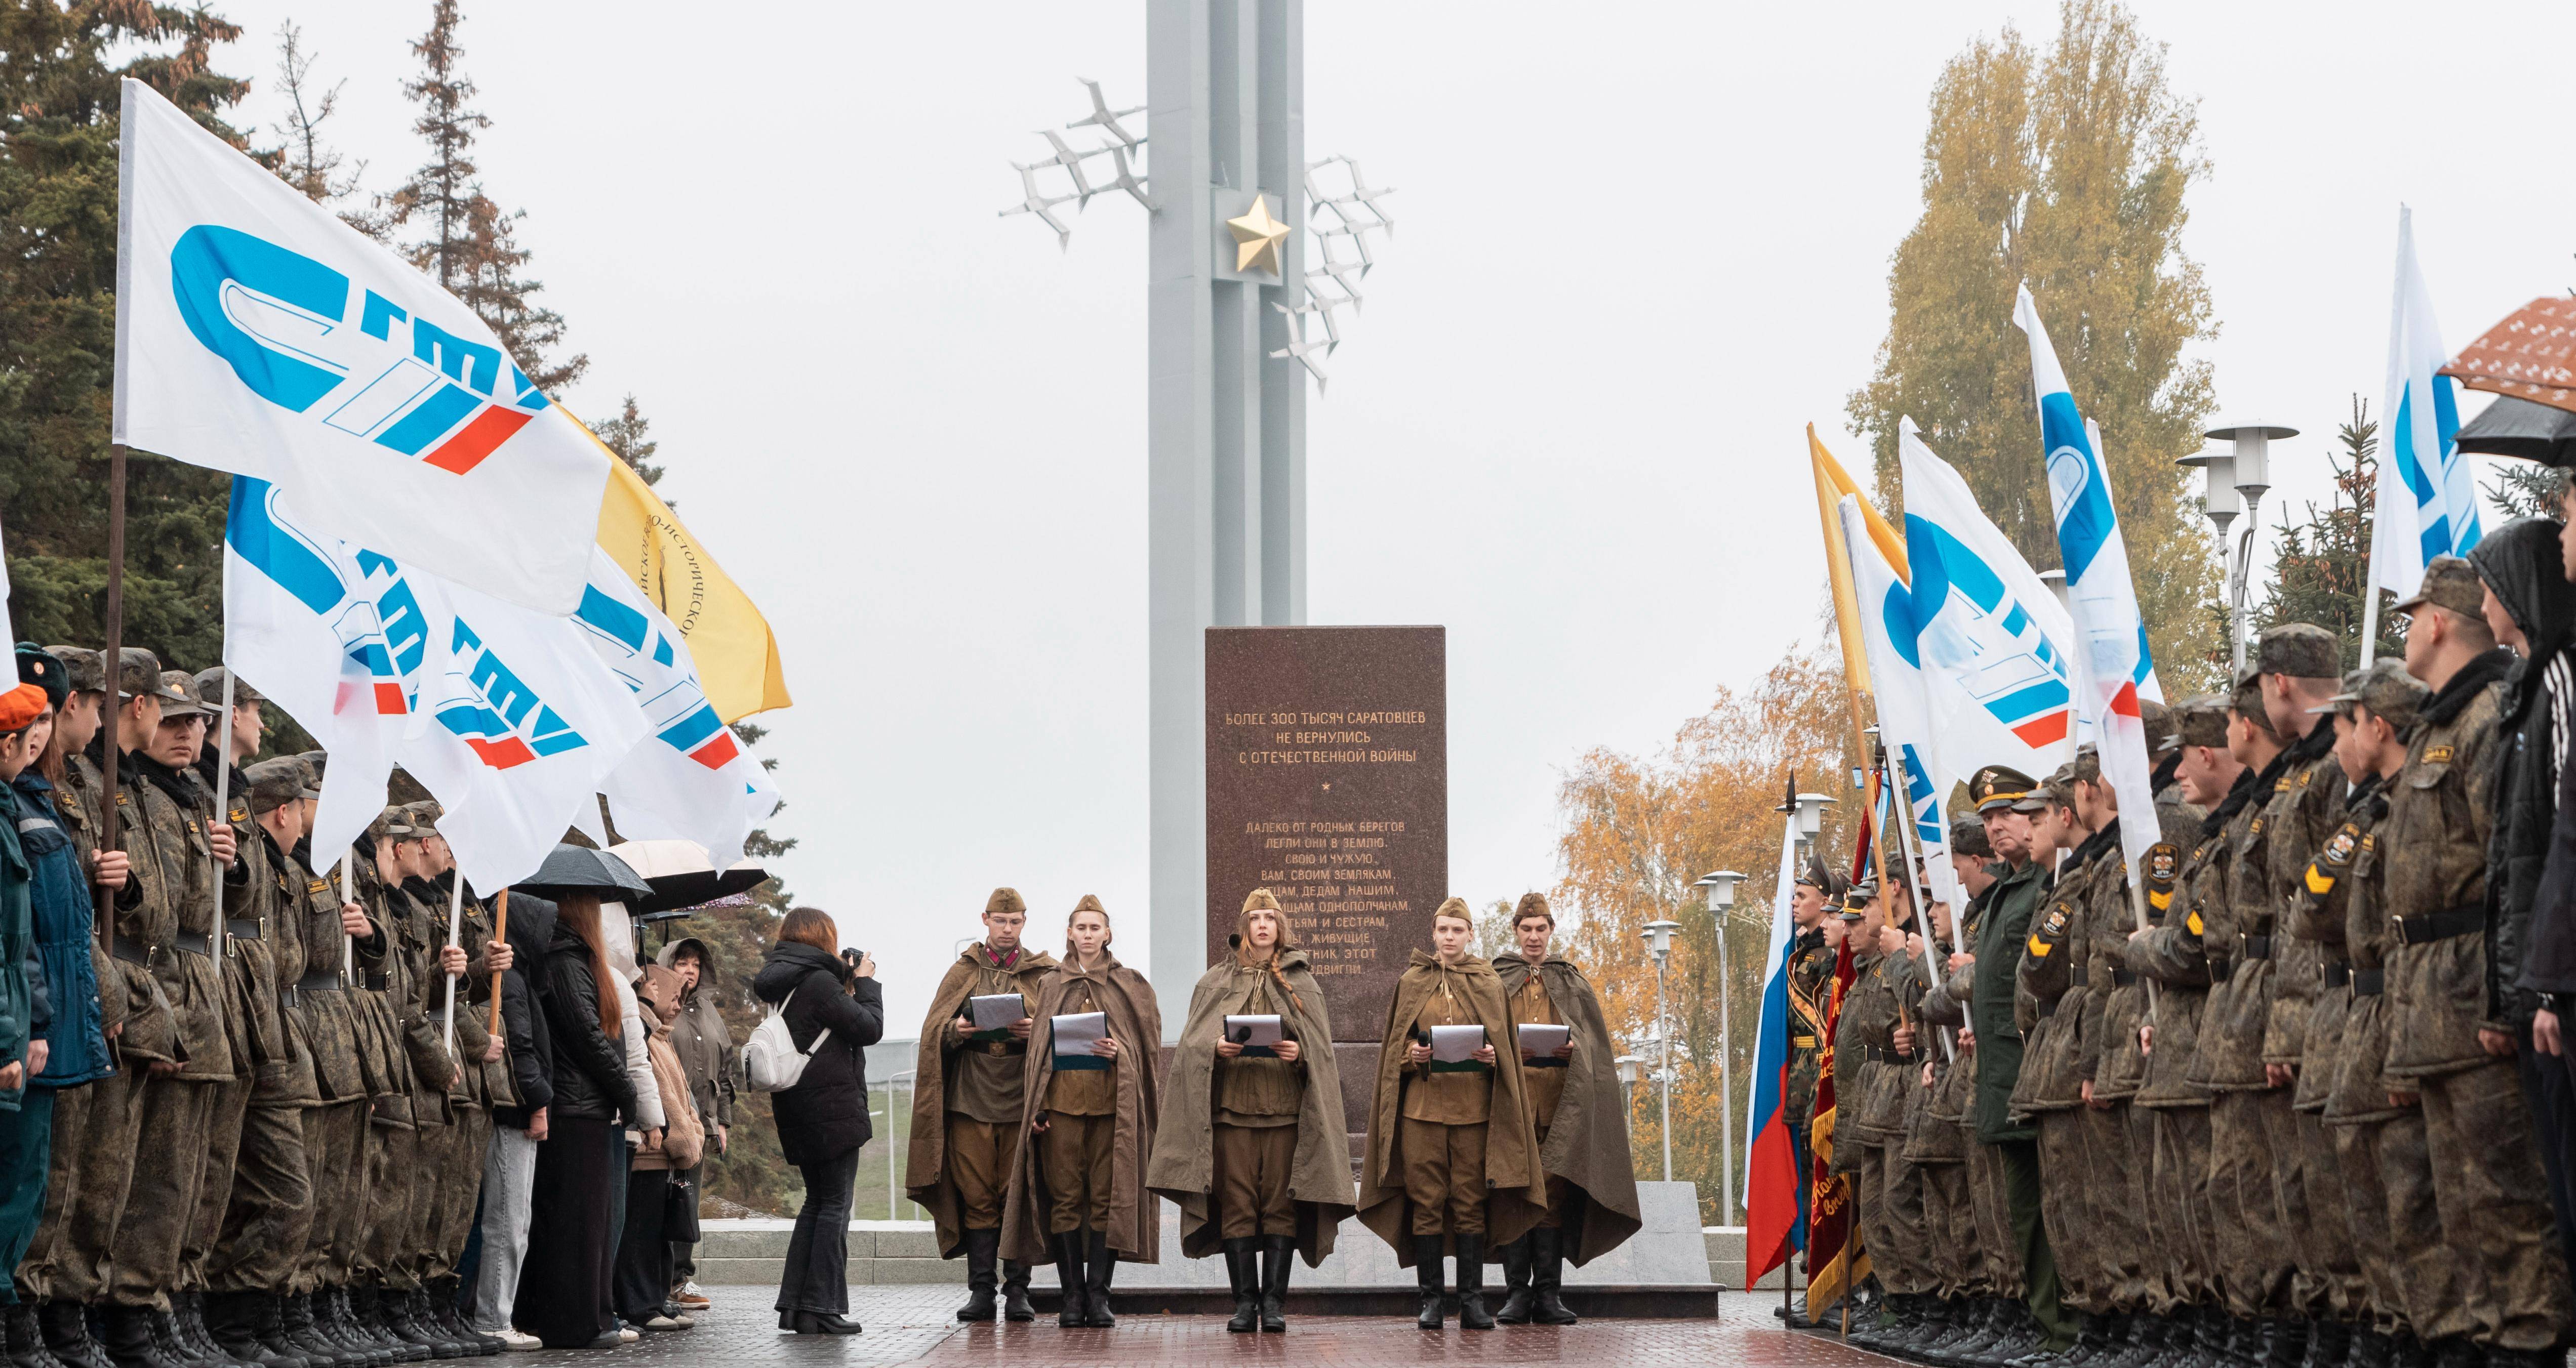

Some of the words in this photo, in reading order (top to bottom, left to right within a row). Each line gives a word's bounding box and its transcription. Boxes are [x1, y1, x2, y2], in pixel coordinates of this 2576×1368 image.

[1225, 713, 1266, 725] БОЛЕЕ
[1301, 712, 1343, 725] ТЫСЯЧ
[1347, 712, 1426, 725] САРАТОВЦЕВ
[1276, 732, 1291, 743] НЕ
[1296, 731, 1371, 743] ВЕРНУЛИСЬ
[1239, 752, 1246, 764] С
[1251, 749, 1365, 764] ОТЕЧЕСТВЕННОЙ
[1370, 748, 1417, 762] ВОЙНЫ
[1245, 822, 1289, 834] ДАЛЕКО
[1293, 822, 1306, 832] ОТ
[1311, 822, 1354, 834] РОДНЫХ
[1360, 822, 1405, 832] БЕРЕГОВ
[1265, 838, 1301, 848] ЛЕГЛИ
[1305, 838, 1326, 848] ОНИ
[1331, 838, 1337, 848] В
[1285, 854, 1315, 864] СВОЮ
[1320, 854, 1327, 864] И
[1291, 869, 1330, 881] СВОИМ
[1302, 886, 1340, 898] ДЕДАМ
[1322, 918, 1330, 927] И
[1345, 948, 1377, 959] ЭТОТ
